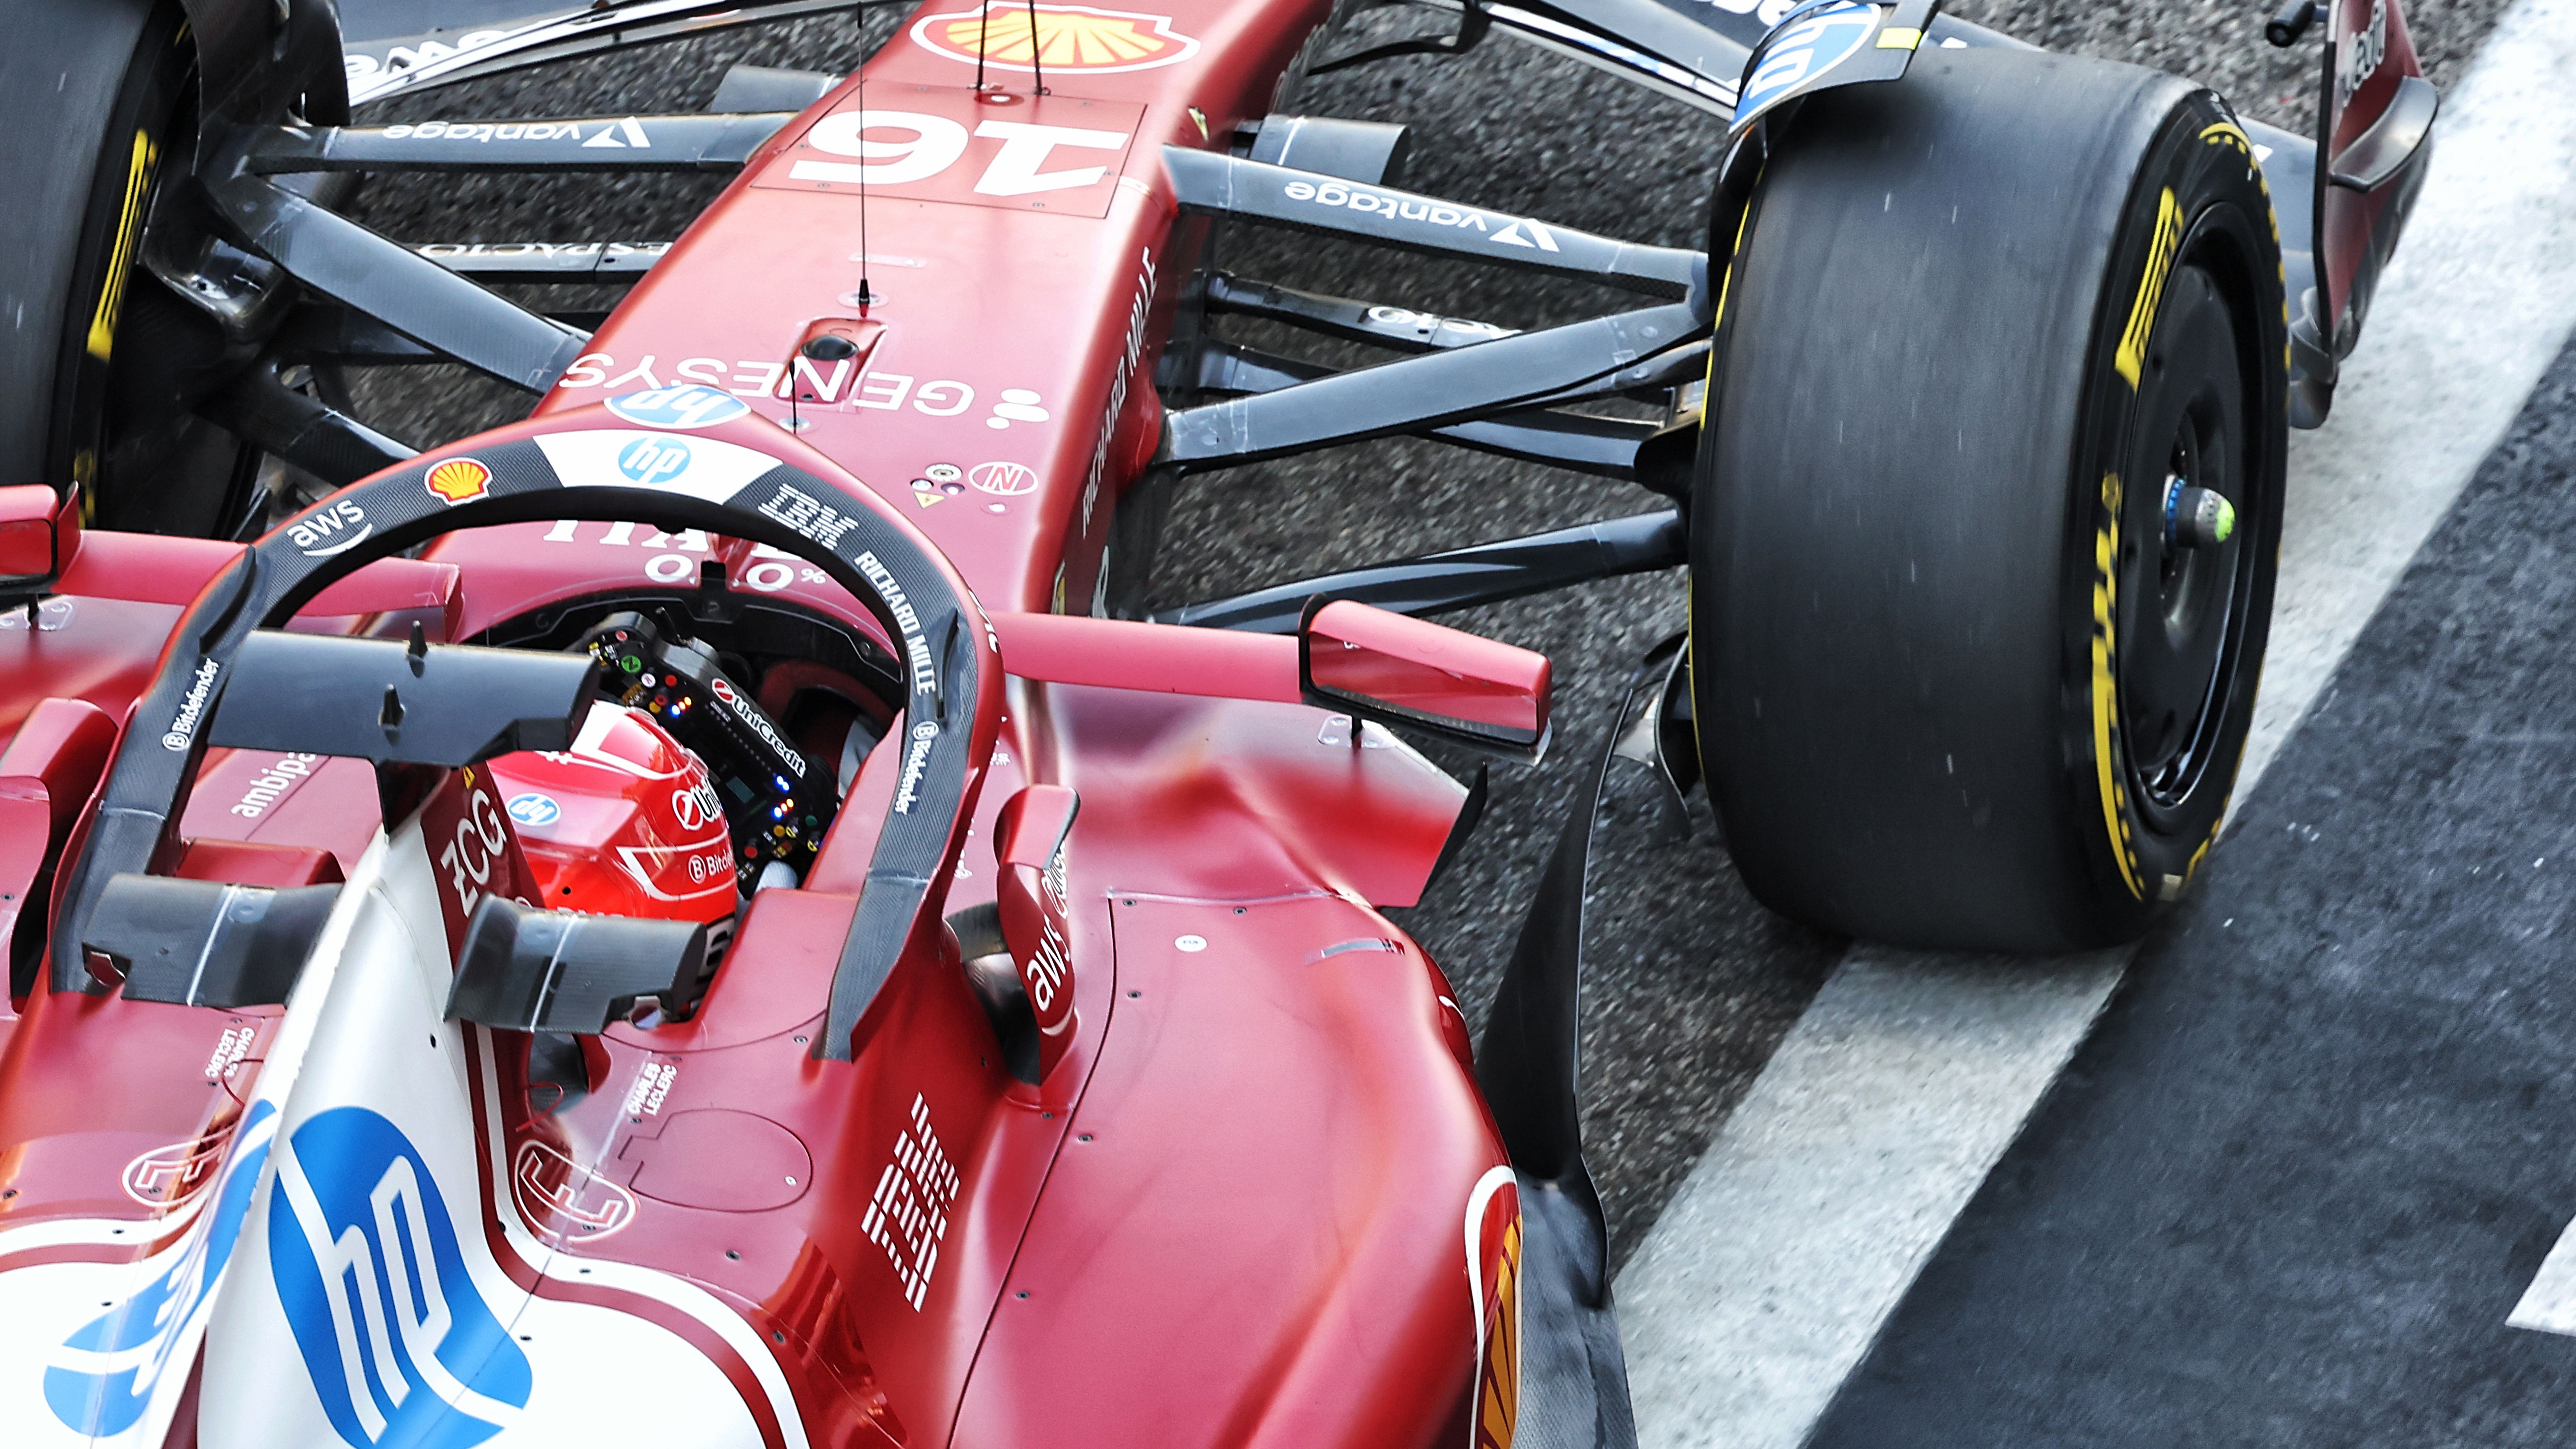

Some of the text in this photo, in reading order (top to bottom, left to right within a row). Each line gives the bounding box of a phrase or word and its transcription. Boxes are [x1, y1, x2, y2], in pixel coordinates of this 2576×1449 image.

[382, 121, 580, 143] vantage
[789, 110, 1130, 196] 16
[1284, 180, 1487, 231] vantage
[558, 353, 976, 416] GENESYS
[610, 385, 746, 424] hp
[1082, 355, 1127, 540] RICHARD
[1126, 246, 1157, 378] MILLE
[618, 437, 691, 484] hp
[982, 466, 1019, 491] N
[287, 499, 365, 548] aws
[758, 483, 859, 551] IBM
[854, 550, 937, 696] RICHARD MILLE
[172, 658, 219, 735] Bitdefender
[731, 694, 806, 778] UniCredit
[508, 795, 558, 823] hp
[894, 739, 933, 815] Bitdefender
[440, 789, 507, 918] ZCG
[1026, 914, 1071, 1012] aws
[204, 1028, 239, 1079] LECLERC
[627, 1062, 662, 1115] CHARLES
[643, 1064, 679, 1116] LECLERC
[860, 1091, 961, 1313] IBM
[268, 1107, 532, 1449] hp
